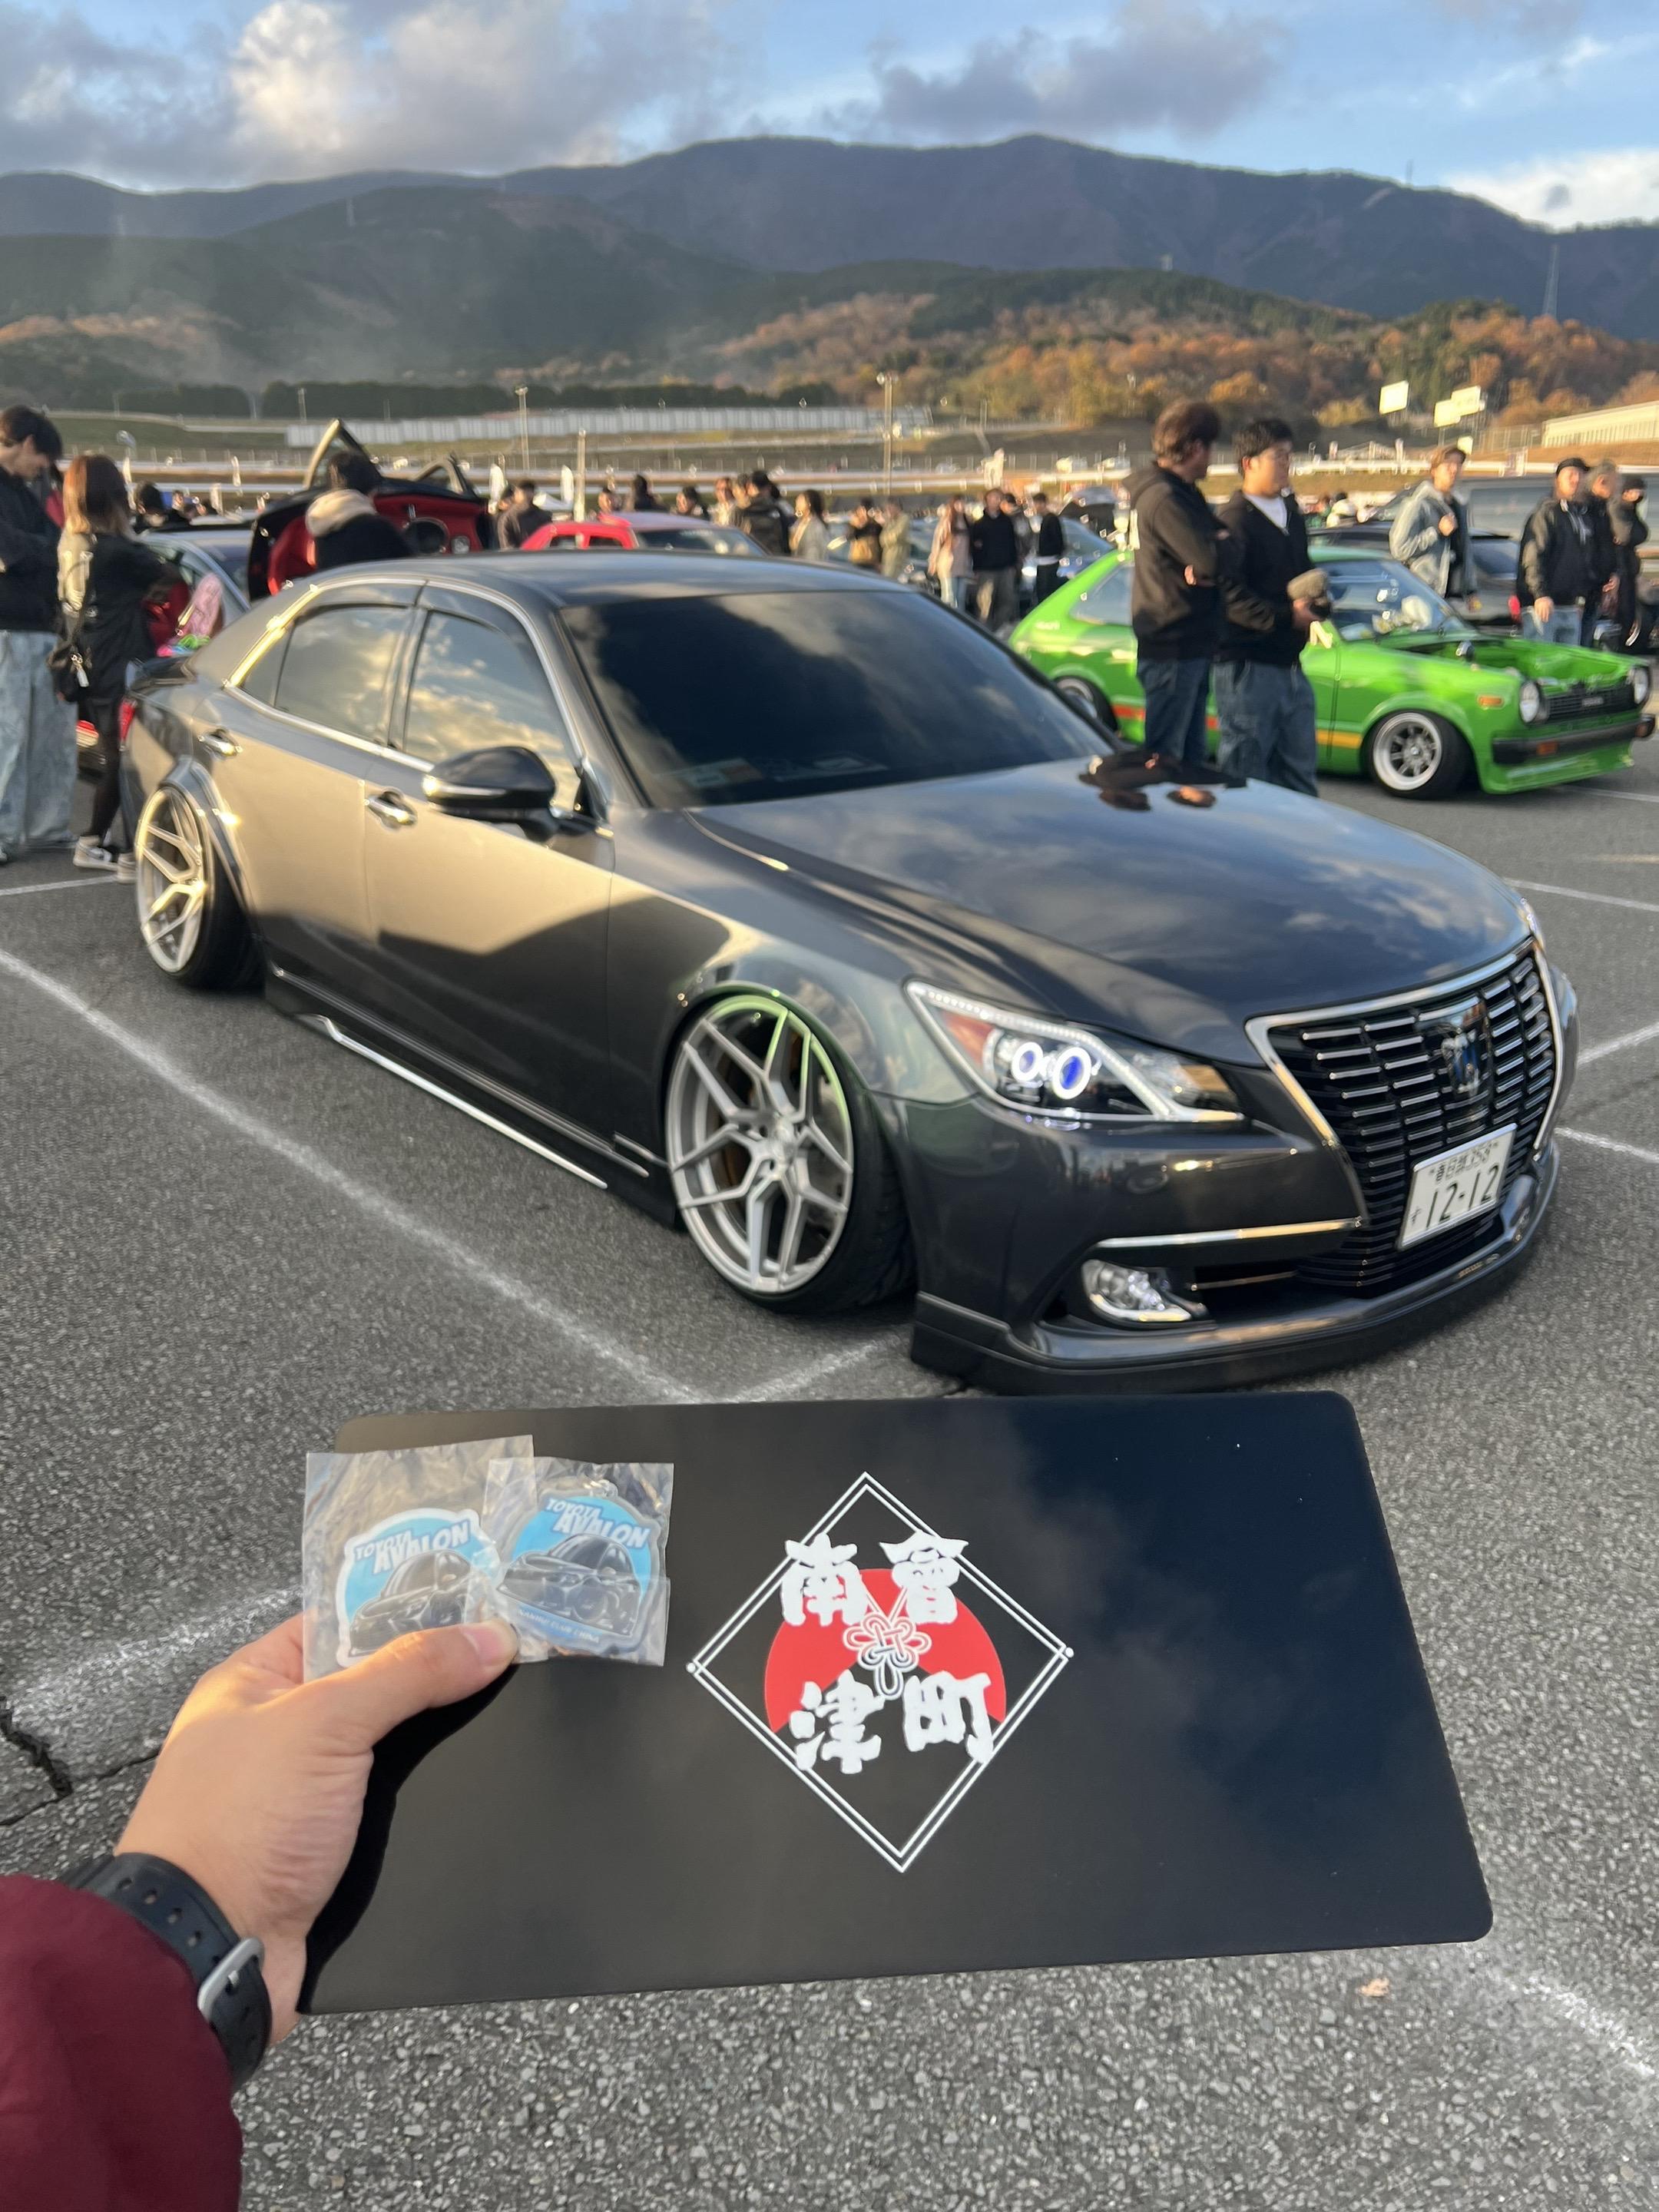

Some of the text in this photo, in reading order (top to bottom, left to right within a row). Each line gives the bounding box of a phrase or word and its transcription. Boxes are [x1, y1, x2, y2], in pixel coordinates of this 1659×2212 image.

[1426, 1164, 1498, 1230] 12-12
[545, 1498, 601, 1520] TOYOTA
[355, 1530, 412, 1560] TOYOTA
[374, 1521, 471, 1573] AVALON
[554, 1512, 651, 1548] AVALON
